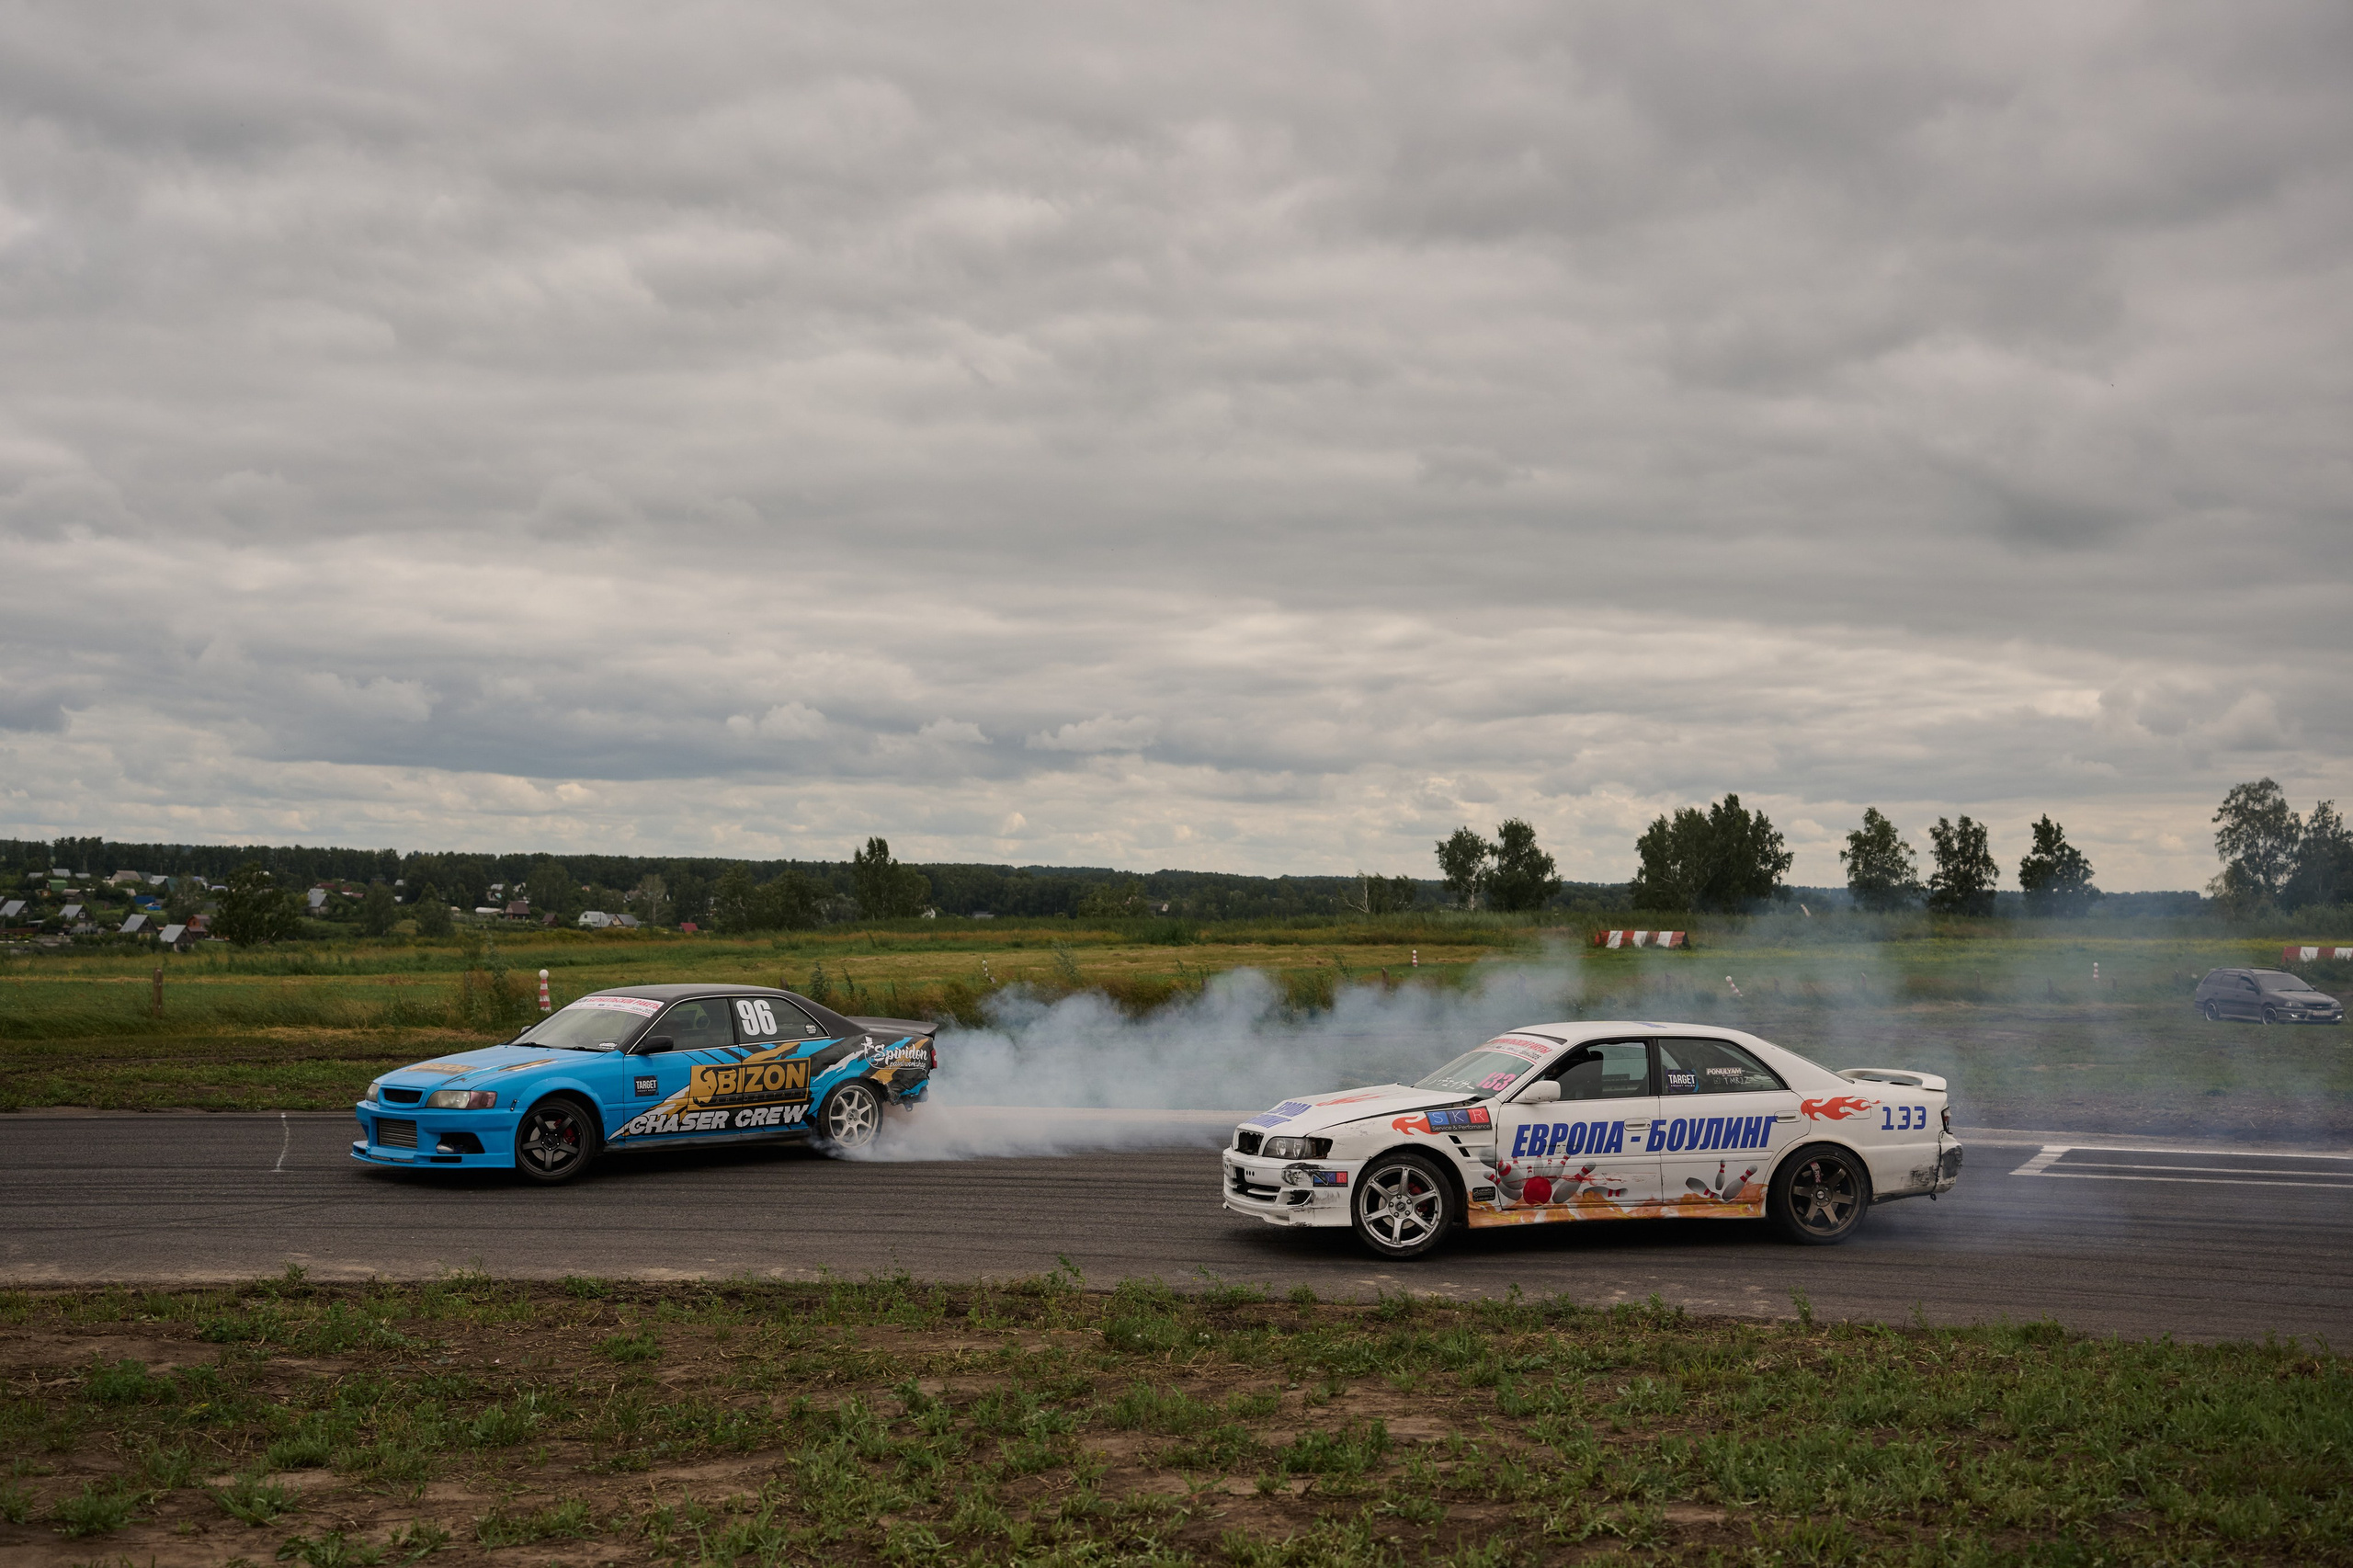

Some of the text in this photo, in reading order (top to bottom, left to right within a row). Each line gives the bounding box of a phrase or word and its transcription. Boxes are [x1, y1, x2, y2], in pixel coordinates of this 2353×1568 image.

[736, 999, 778, 1036] 96
[873, 1043, 928, 1065] Spiridon
[635, 1079, 657, 1090] TARGET
[716, 1062, 806, 1095] BIZON
[1476, 1072, 1517, 1091] 133
[1668, 1074, 1695, 1085] TARGET
[628, 1104, 810, 1134] CHASER CREW
[1432, 1108, 1485, 1124] SKR
[1881, 1106, 1927, 1131] 133
[1511, 1120, 1624, 1157] ЕВРОПА
[1645, 1116, 1779, 1153] БОУЛИНГ
